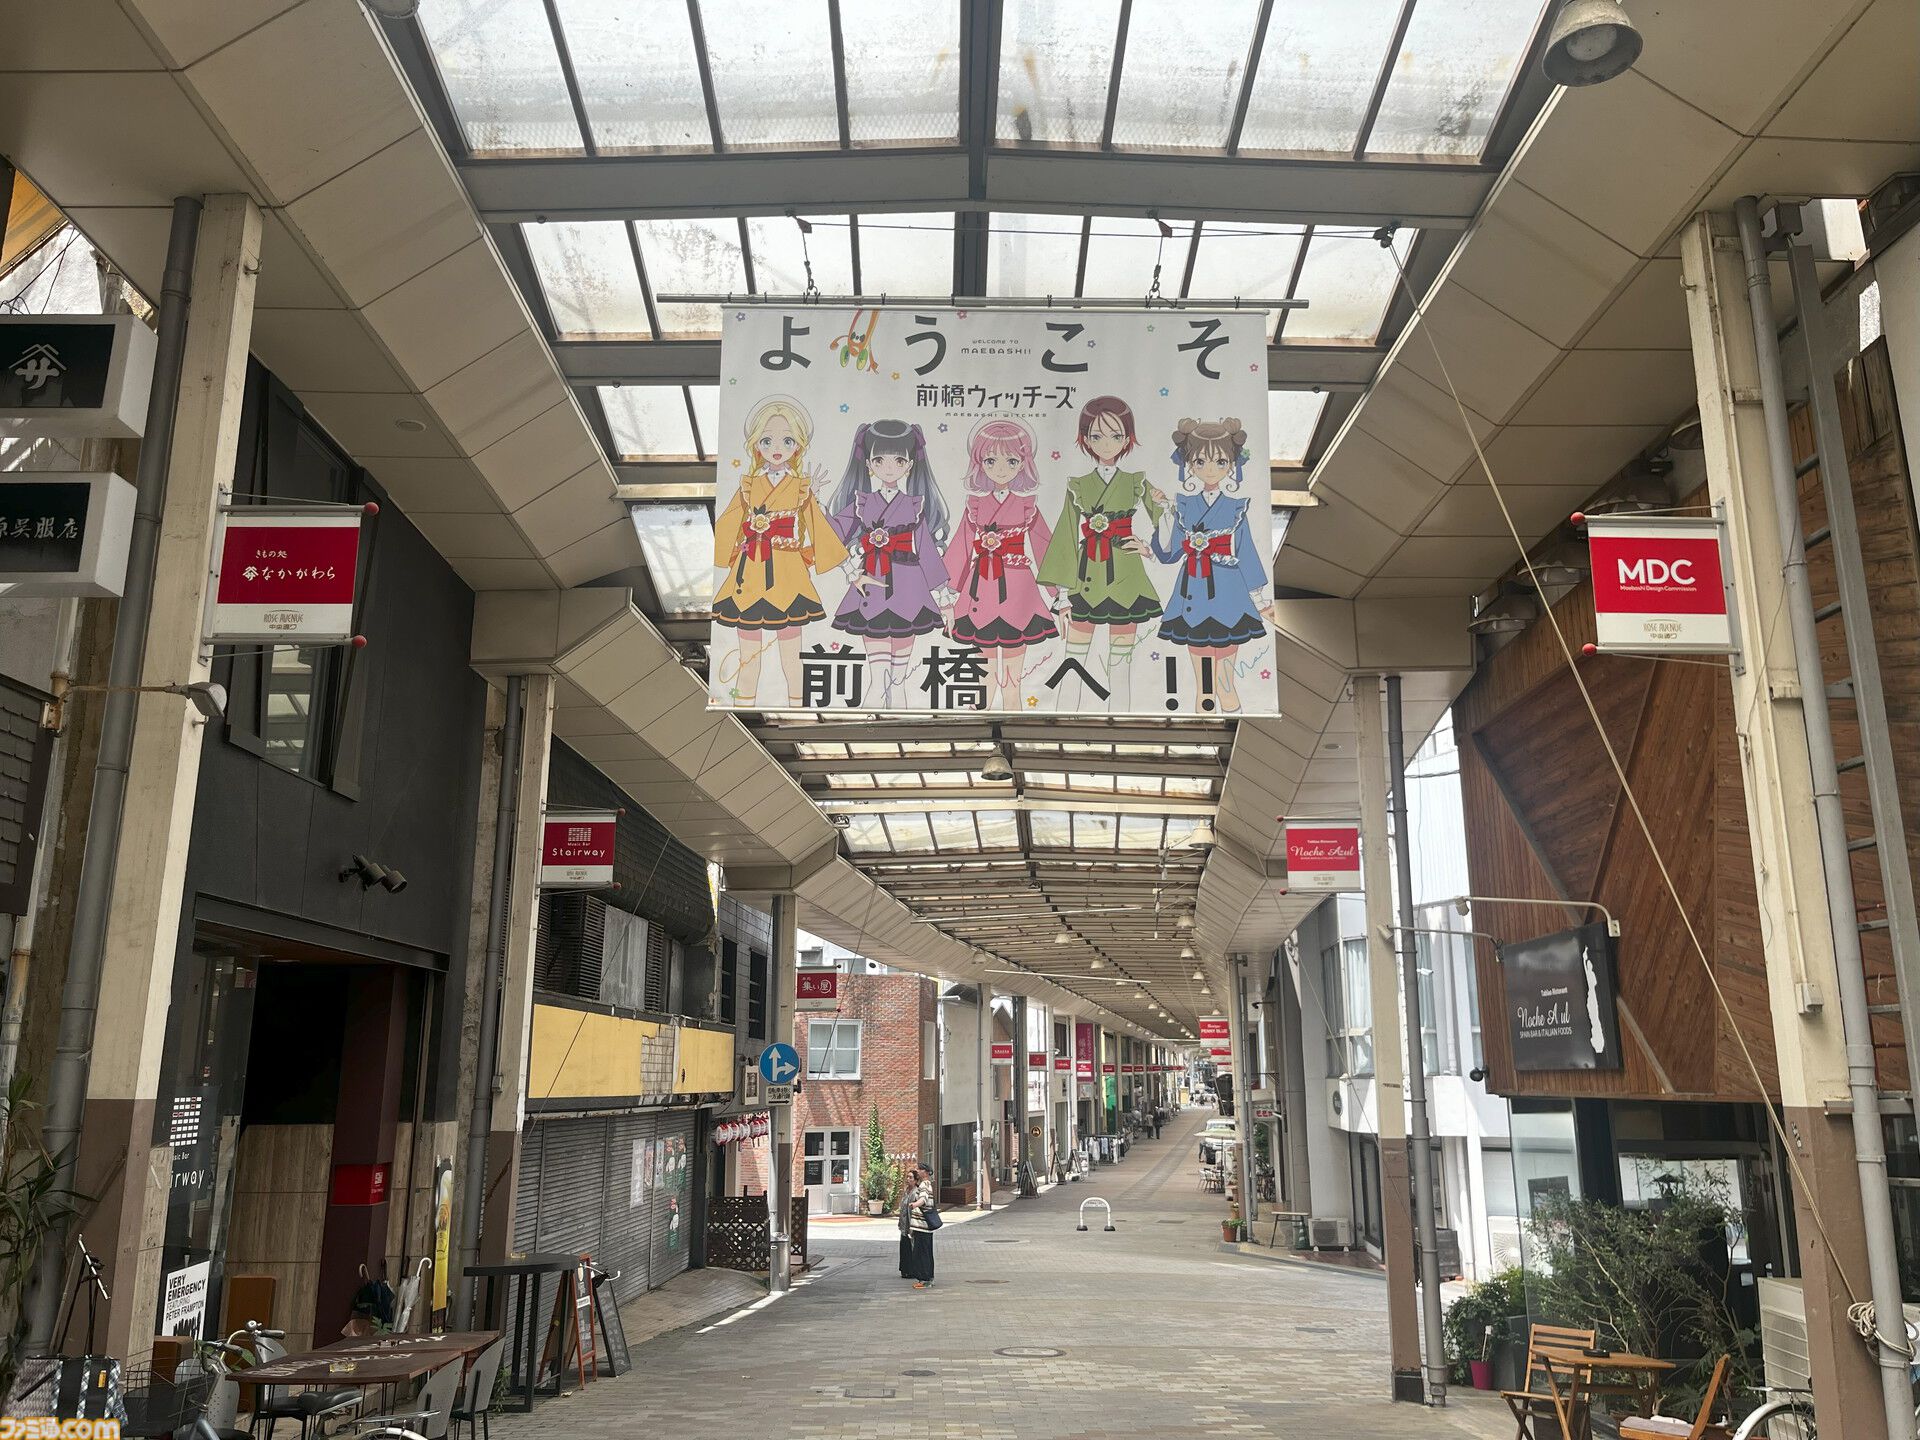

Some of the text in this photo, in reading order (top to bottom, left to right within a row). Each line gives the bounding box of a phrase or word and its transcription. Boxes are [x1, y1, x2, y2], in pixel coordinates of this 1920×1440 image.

[760, 315, 1230, 379] ようこそ
[916, 384, 1076, 409] 前橋ウィッチーズ
[1617, 558, 1696, 585] MDC
[263, 613, 304, 623] ROSE AVENUE
[552, 848, 605, 857] Stairway
[1290, 846, 1354, 856] Noche Azul
[1517, 1006, 1545, 1027] Noche
[168, 1279, 206, 1301] EMERGENCY
[169, 1274, 186, 1289] VERY
[166, 1301, 204, 1320] PETER FRAMPTON
